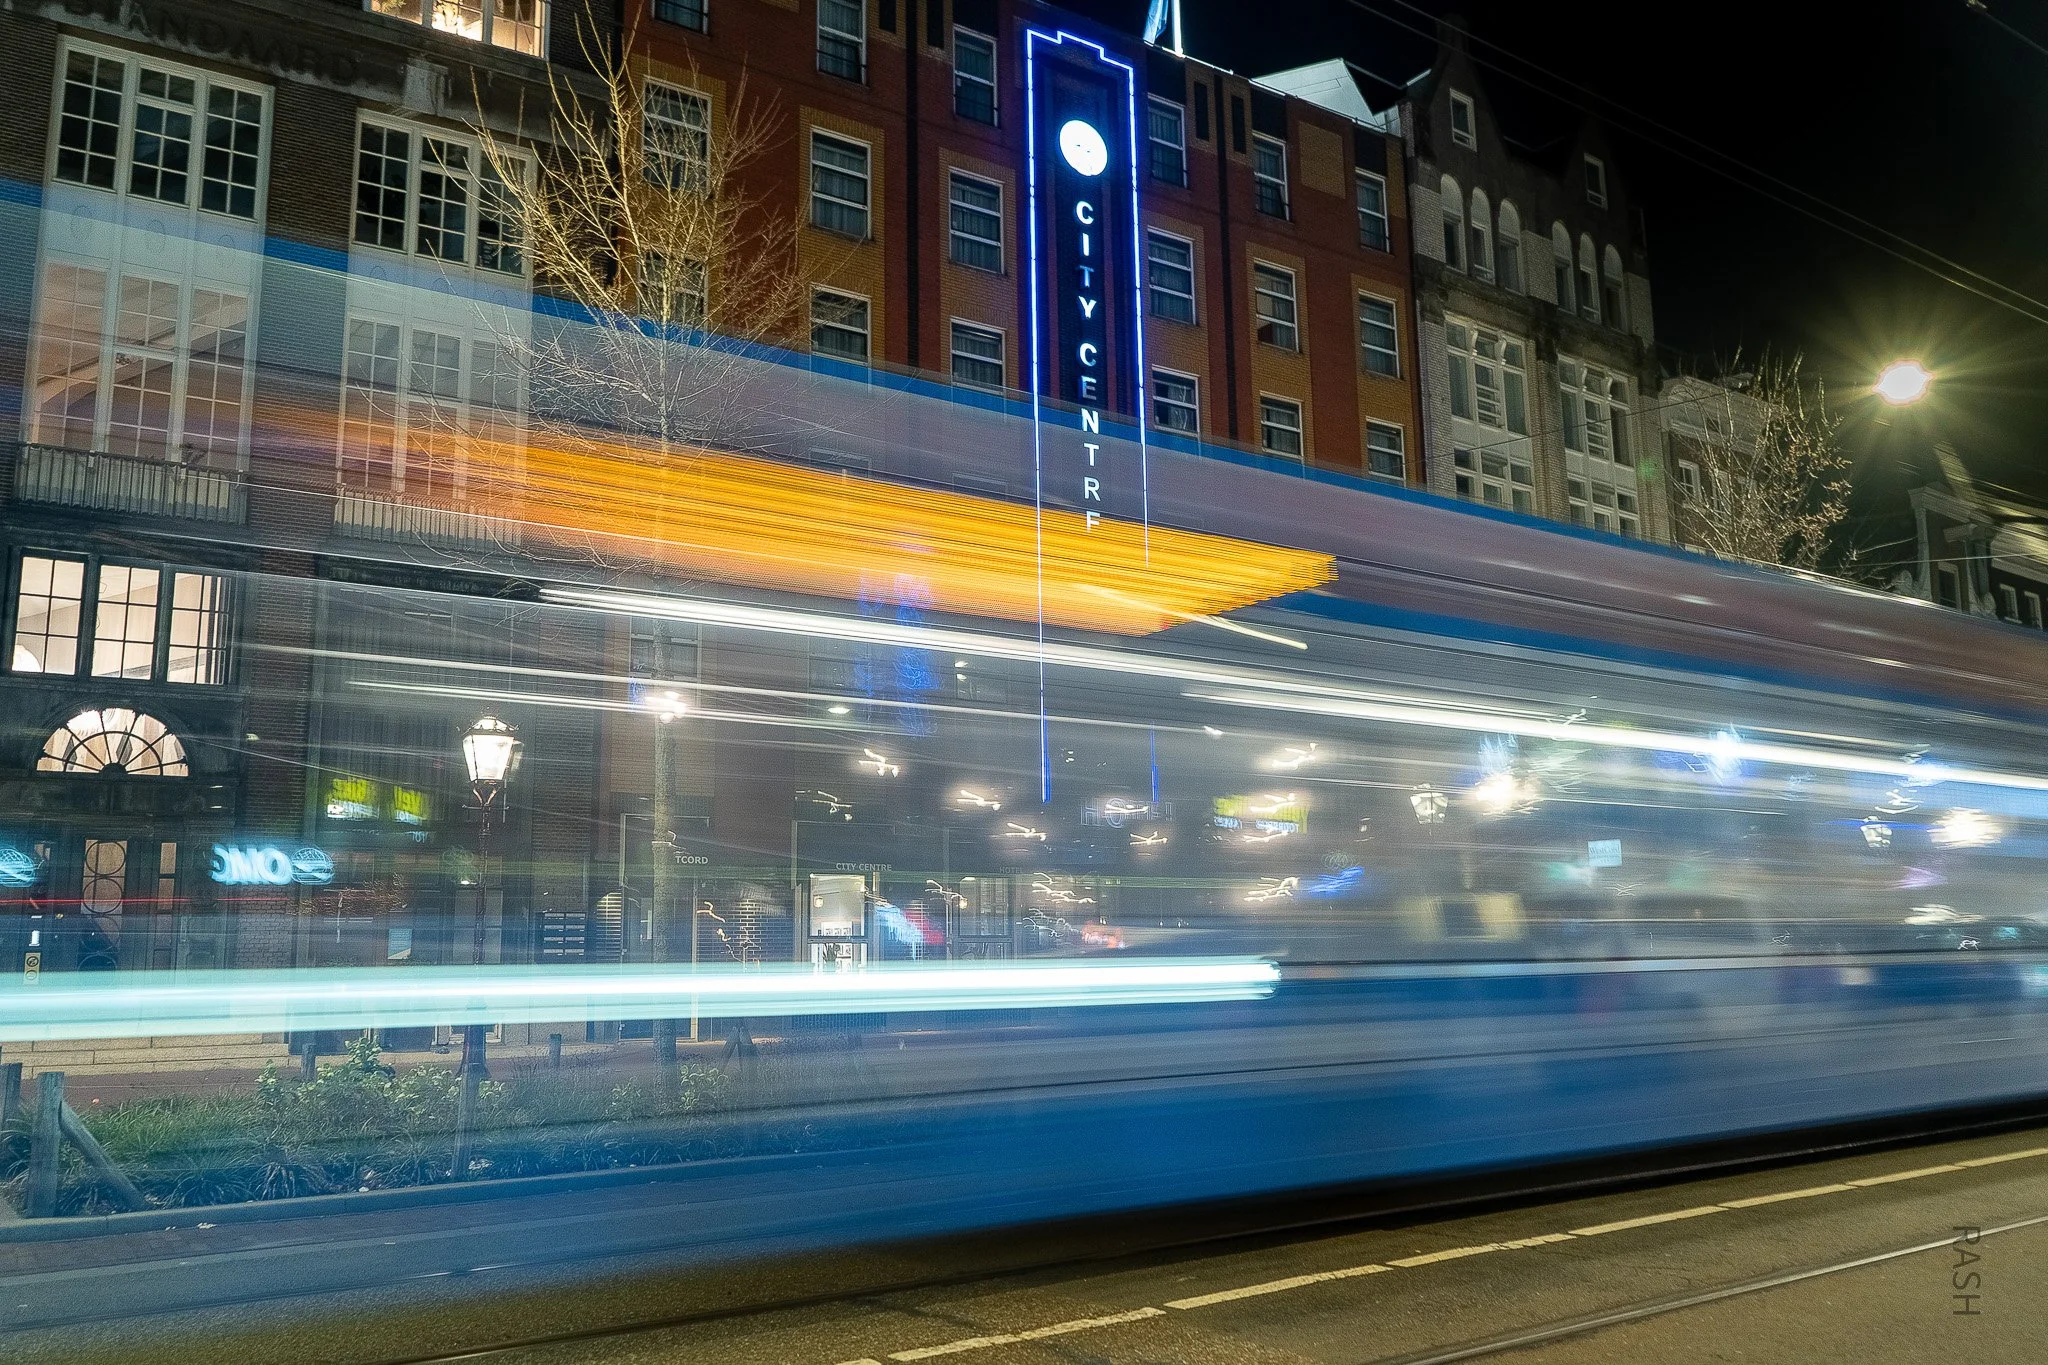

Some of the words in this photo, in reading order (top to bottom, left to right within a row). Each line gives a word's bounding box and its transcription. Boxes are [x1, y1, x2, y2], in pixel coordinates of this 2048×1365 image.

[1075, 200, 1097, 319] CITY
[674, 855, 709, 865] TCORD
[835, 862, 857, 871] CITY
[858, 863, 892, 872] CENTRE
